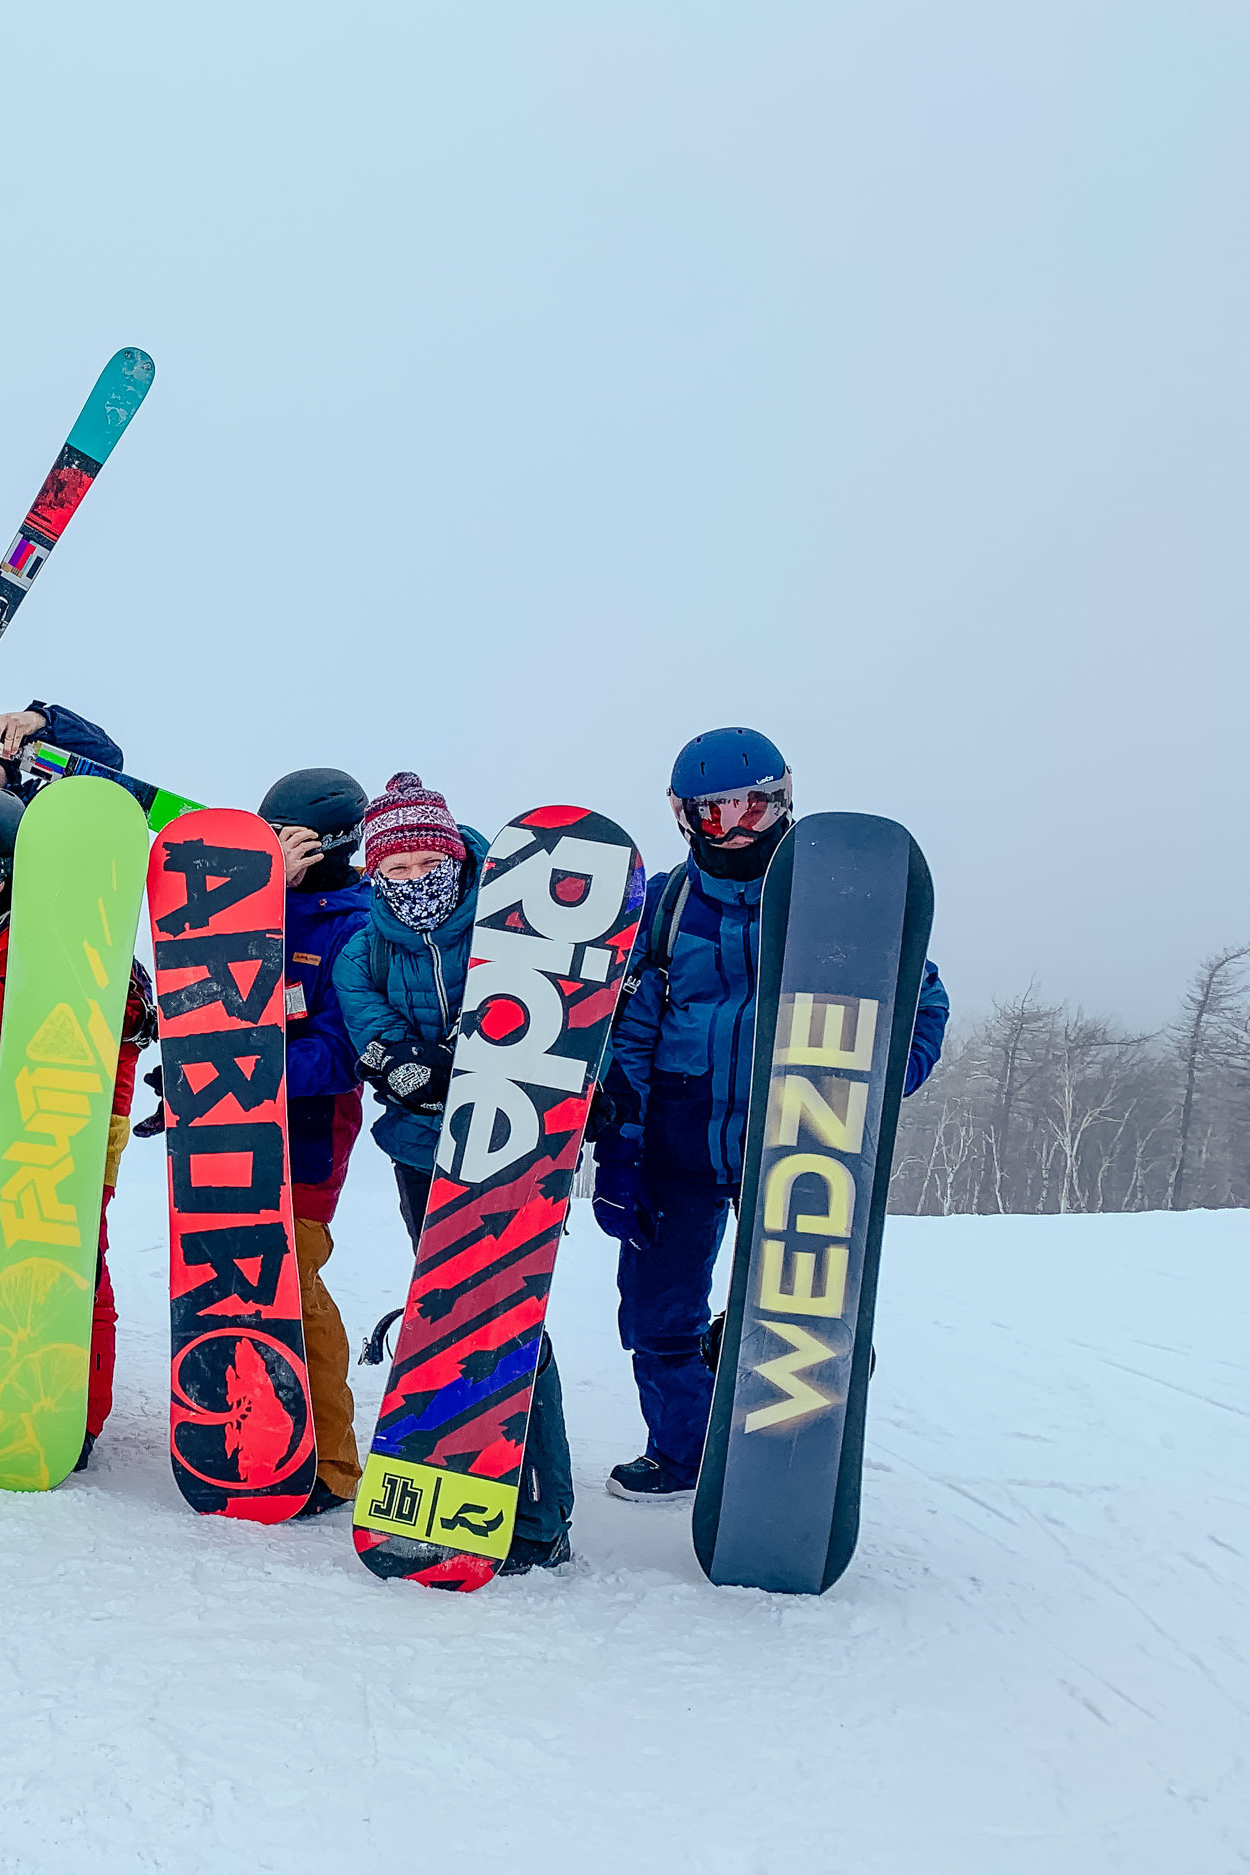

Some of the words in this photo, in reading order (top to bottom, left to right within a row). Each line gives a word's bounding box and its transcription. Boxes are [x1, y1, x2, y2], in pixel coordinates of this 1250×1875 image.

[155, 838, 289, 1320] ARBOR
[434, 825, 632, 1184] Ride
[743, 991, 879, 1435] WEDZE
